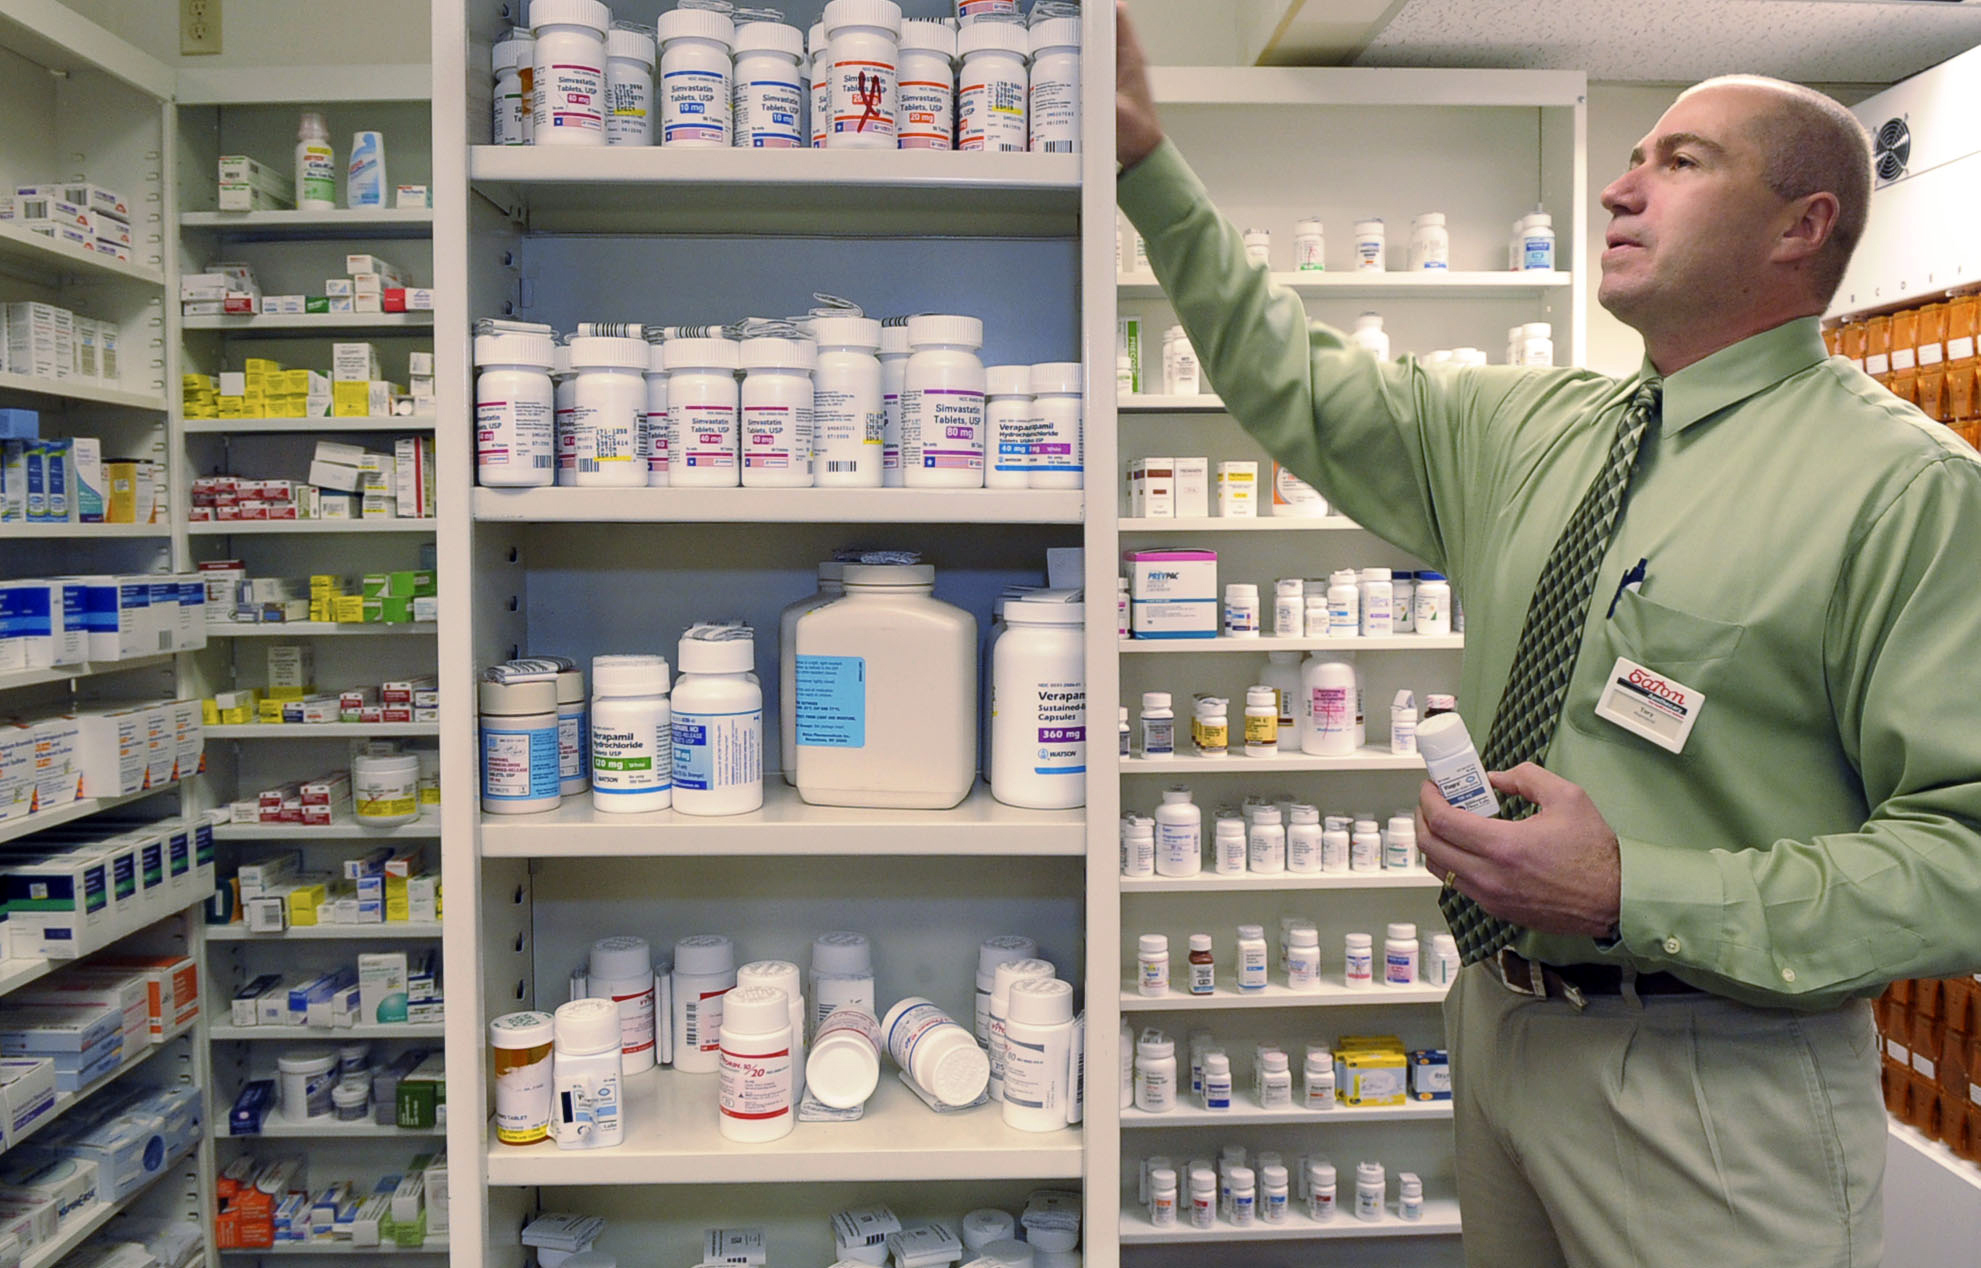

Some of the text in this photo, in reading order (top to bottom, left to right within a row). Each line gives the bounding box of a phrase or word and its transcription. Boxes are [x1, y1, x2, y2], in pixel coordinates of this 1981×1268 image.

[671, 85, 713, 93] Simvastatin
[699, 94, 714, 102] USP
[762, 94, 798, 106] Simvastatin
[901, 94, 943, 104] Simvastatin
[680, 103, 704, 113] 10 mg
[789, 107, 799, 115] USP
[929, 104, 943, 112] USP
[773, 113, 794, 125] 10 mg
[910, 113, 934, 124] 20 mg
[935, 403, 980, 415] Simvastatin
[692, 417, 729, 426] Simvastatin
[934, 414, 981, 426] Tablets, USP
[718, 426, 730, 434] USP
[769, 427, 784, 435] USP
[946, 427, 973, 440] 80 mg
[700, 434, 723, 445] 40 mg
[762, 436, 774, 445] mg
[1013, 446, 1026, 454] mg
[1147, 571, 1180, 582] PREVPAC
[1628, 668, 1686, 705] Eaton
[1038, 691, 1086, 703] Verapam
[1038, 713, 1076, 723] Capsules
[1042, 730, 1080, 741] 360 mg
[608, 761, 623, 770] mg
